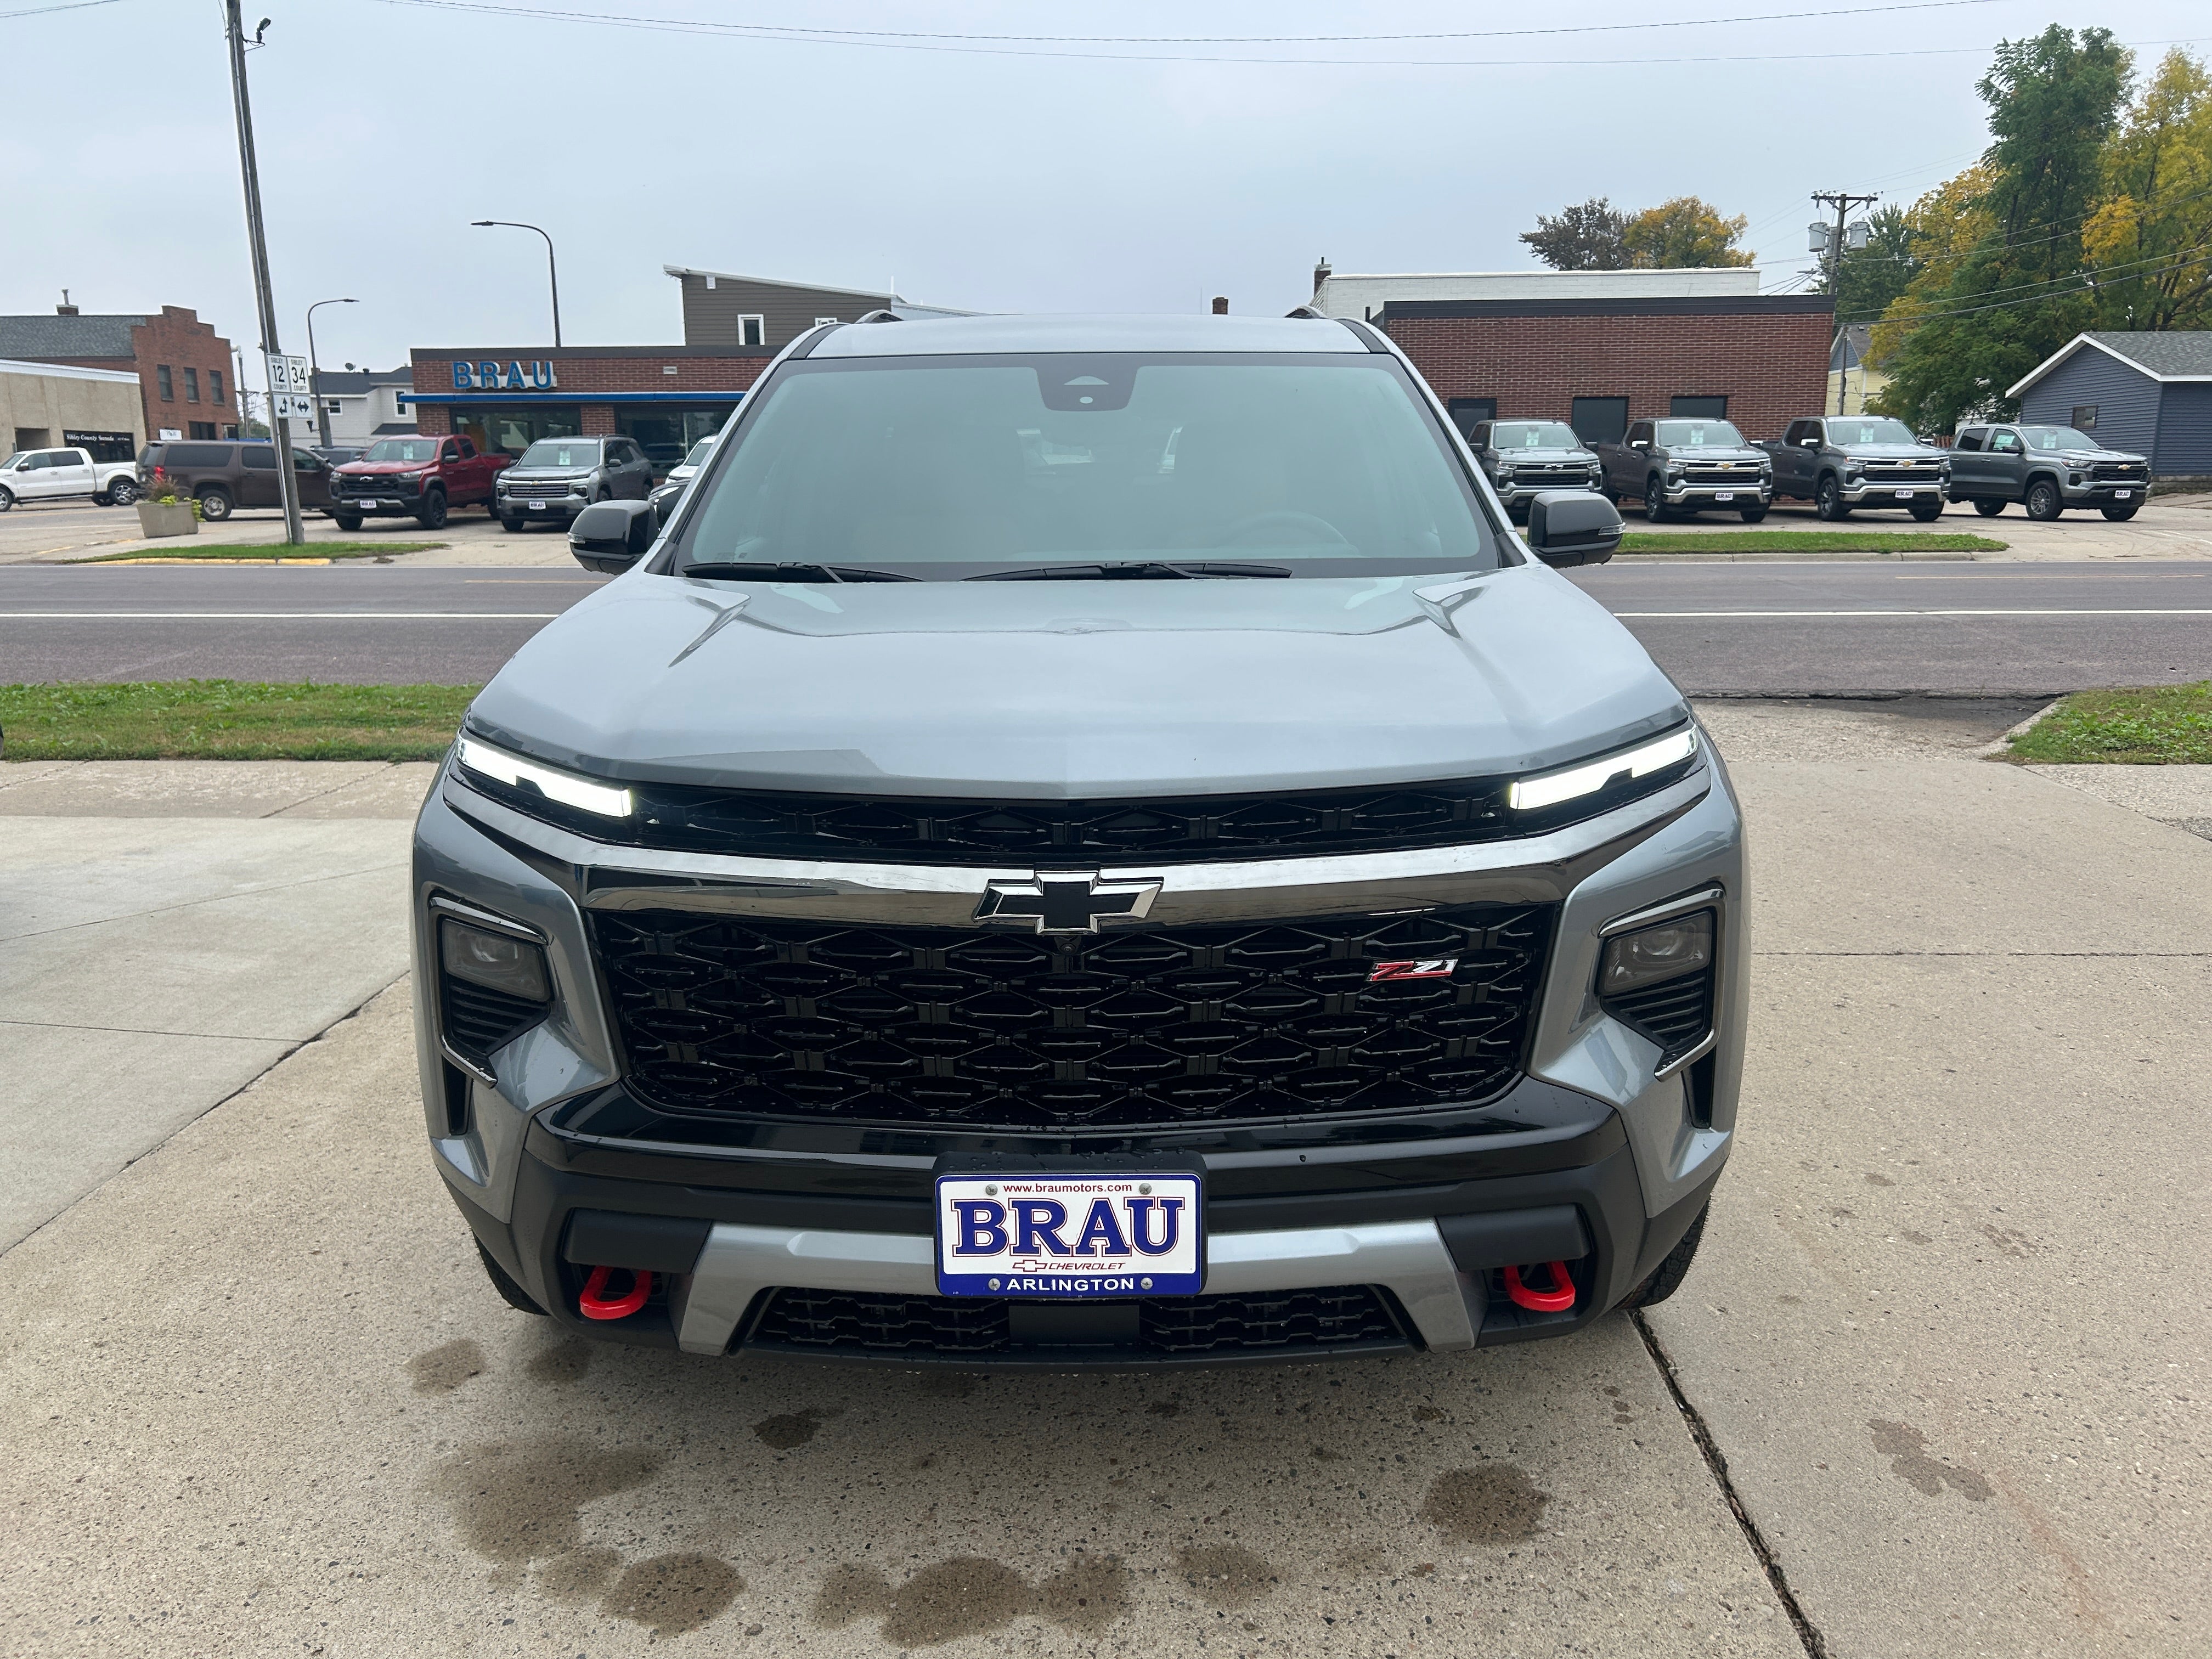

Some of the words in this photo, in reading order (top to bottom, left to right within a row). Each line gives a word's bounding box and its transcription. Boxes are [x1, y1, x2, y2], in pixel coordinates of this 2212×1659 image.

[273, 365, 285, 382] 12
[291, 366, 306, 384] 34
[452, 360, 554, 390] BRAU
[1365, 959, 1458, 981] Z71
[1003, 1183, 1132, 1192] www.braumotors.com
[950, 1197, 1186, 1257] BRAU
[1006, 1278, 1134, 1291] ARLINGTON
